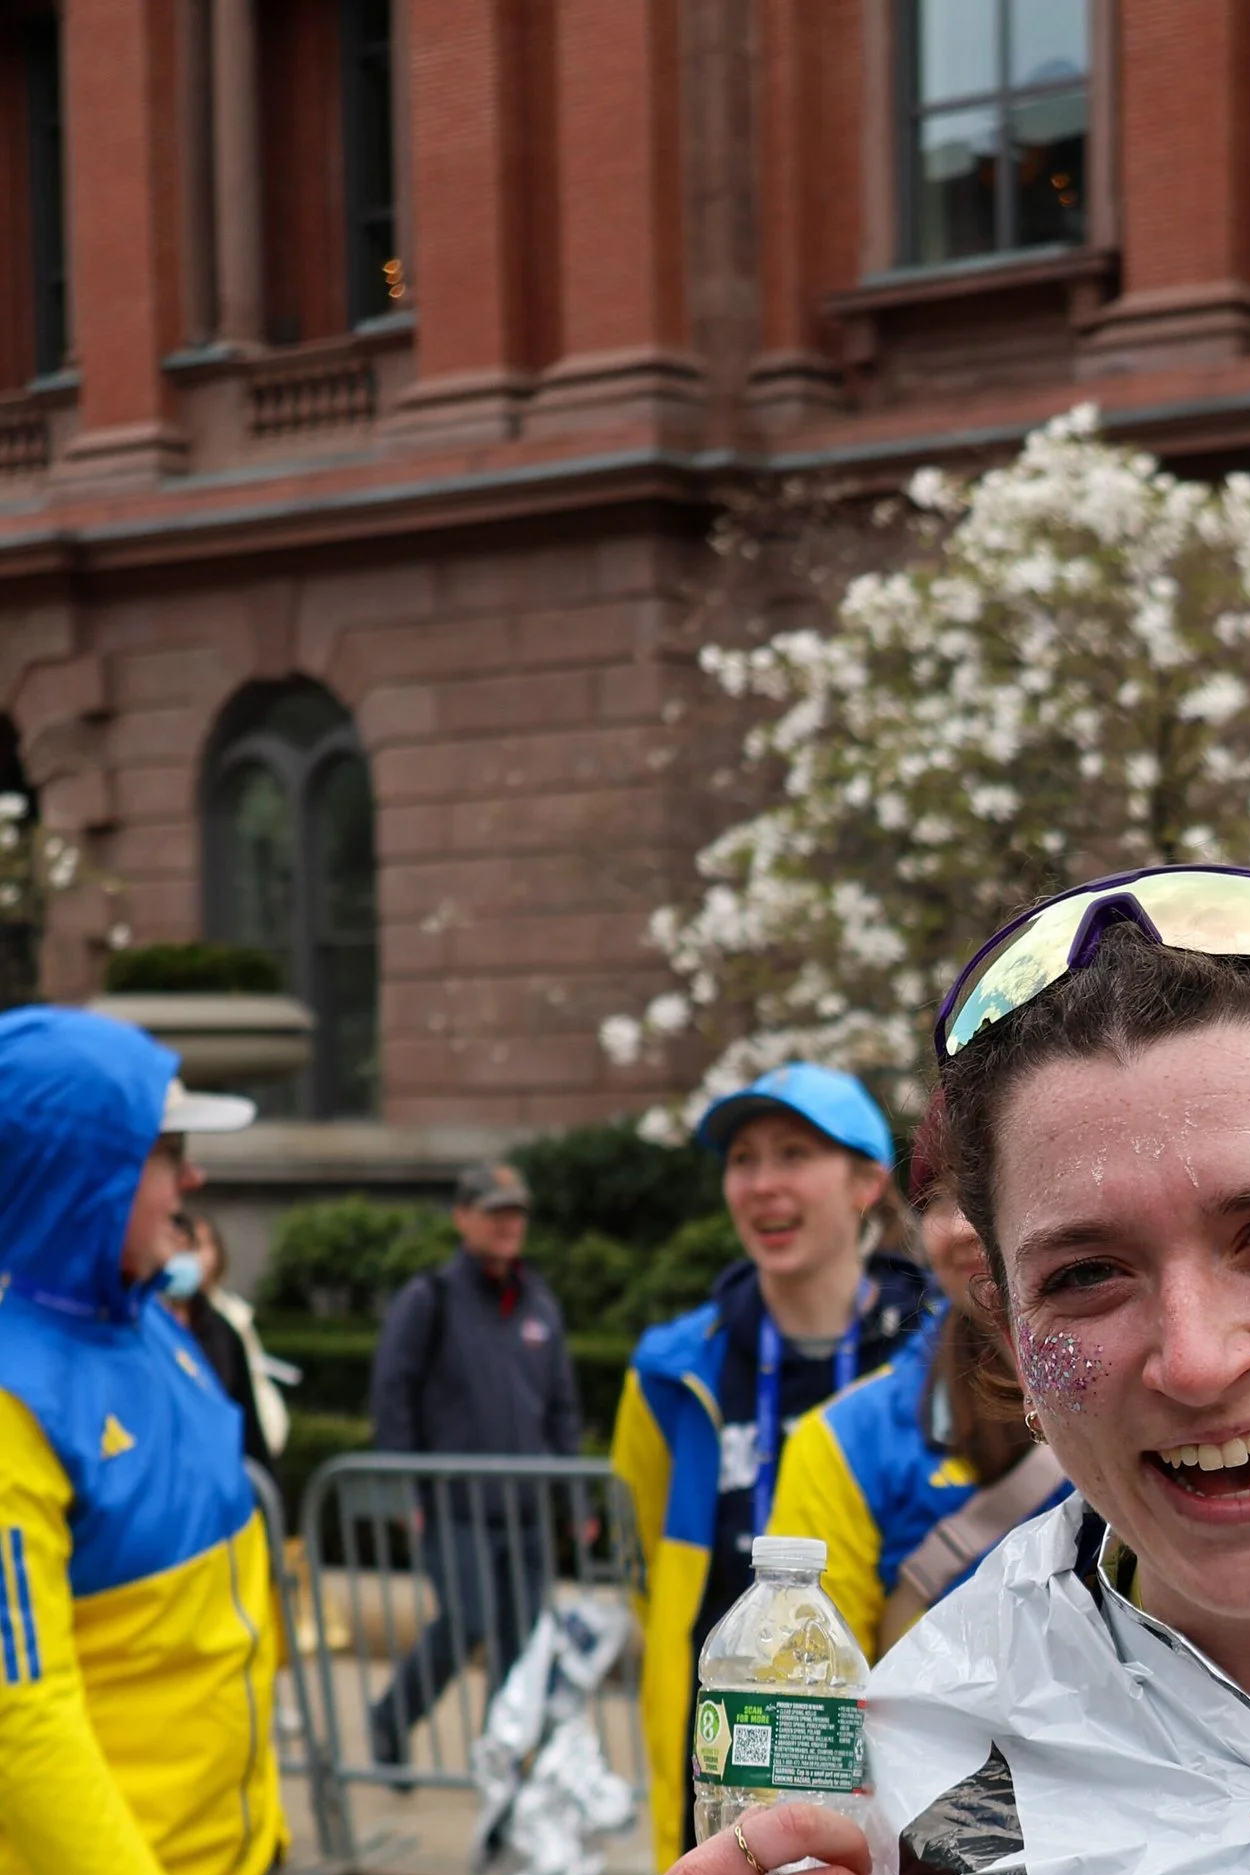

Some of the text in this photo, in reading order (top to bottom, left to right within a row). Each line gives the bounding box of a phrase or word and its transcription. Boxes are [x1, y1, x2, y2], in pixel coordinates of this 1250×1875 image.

[744, 1706, 762, 1714] SCAN
[736, 1714, 748, 1722] FOR
[751, 1715, 769, 1724] MORE
